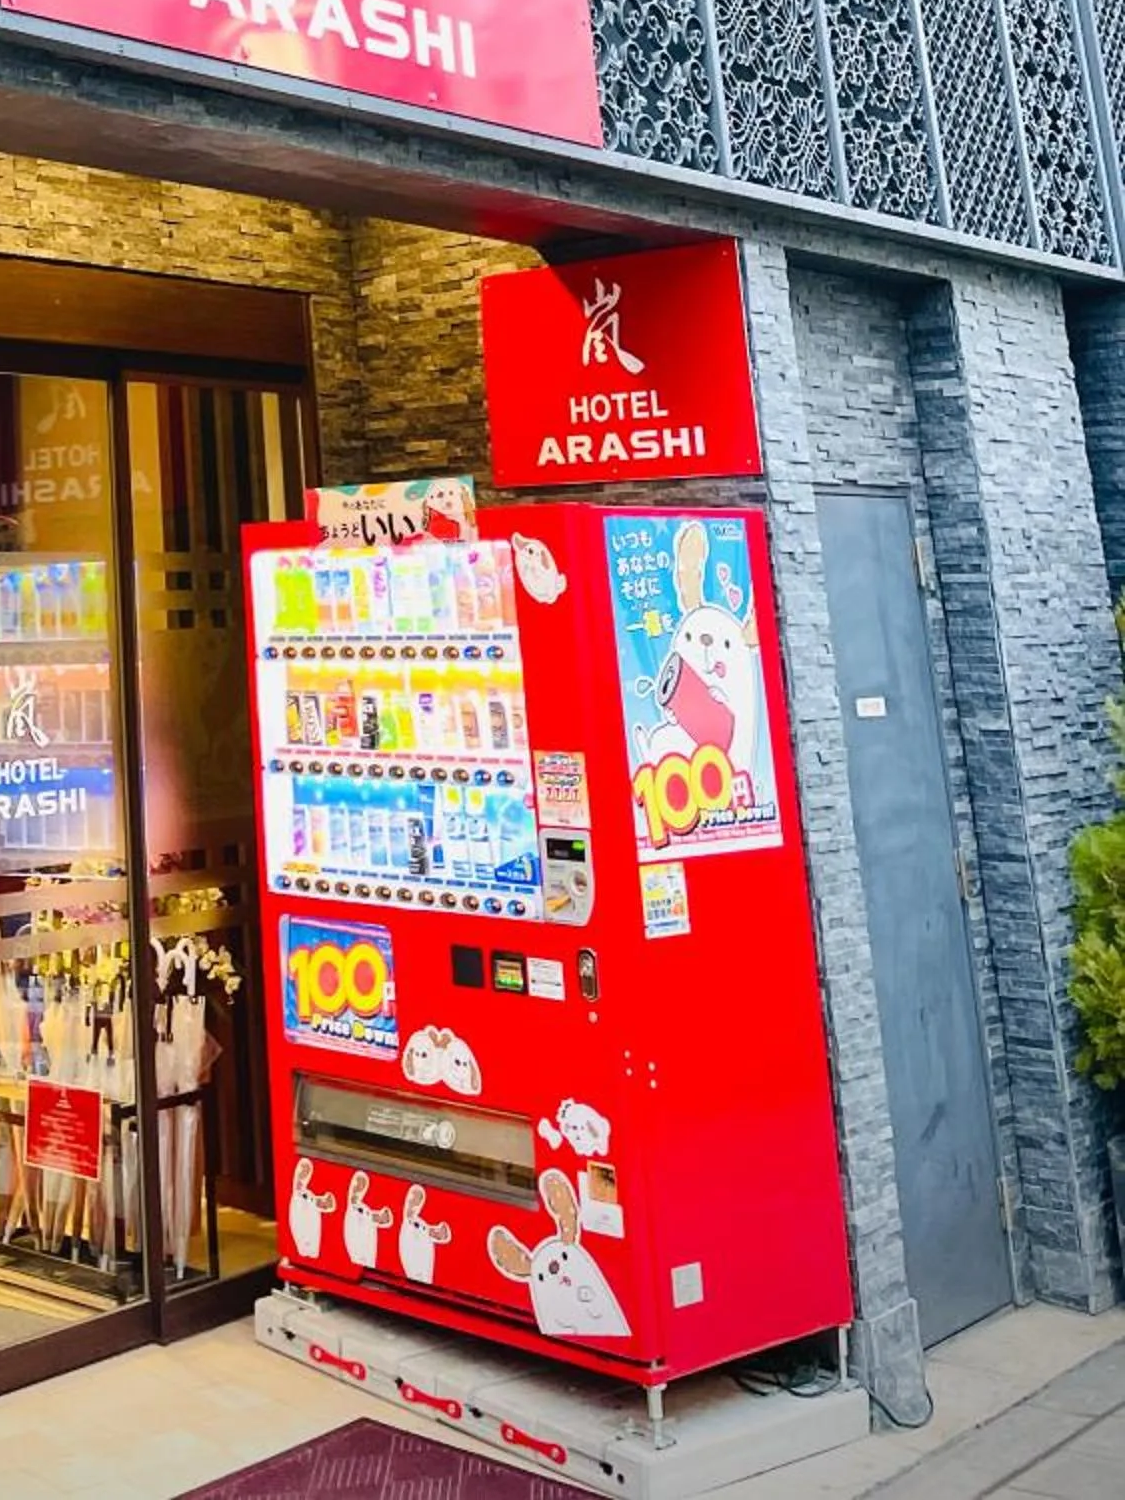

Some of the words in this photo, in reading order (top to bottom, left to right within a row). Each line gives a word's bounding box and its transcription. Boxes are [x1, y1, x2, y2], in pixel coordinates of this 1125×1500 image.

[568, 389, 669, 424] HOTEL
[536, 424, 707, 467] ARASHI
[611, 530, 653, 553] いつも
[616, 551, 671, 577] あなたの
[621, 577, 662, 601] そばに
